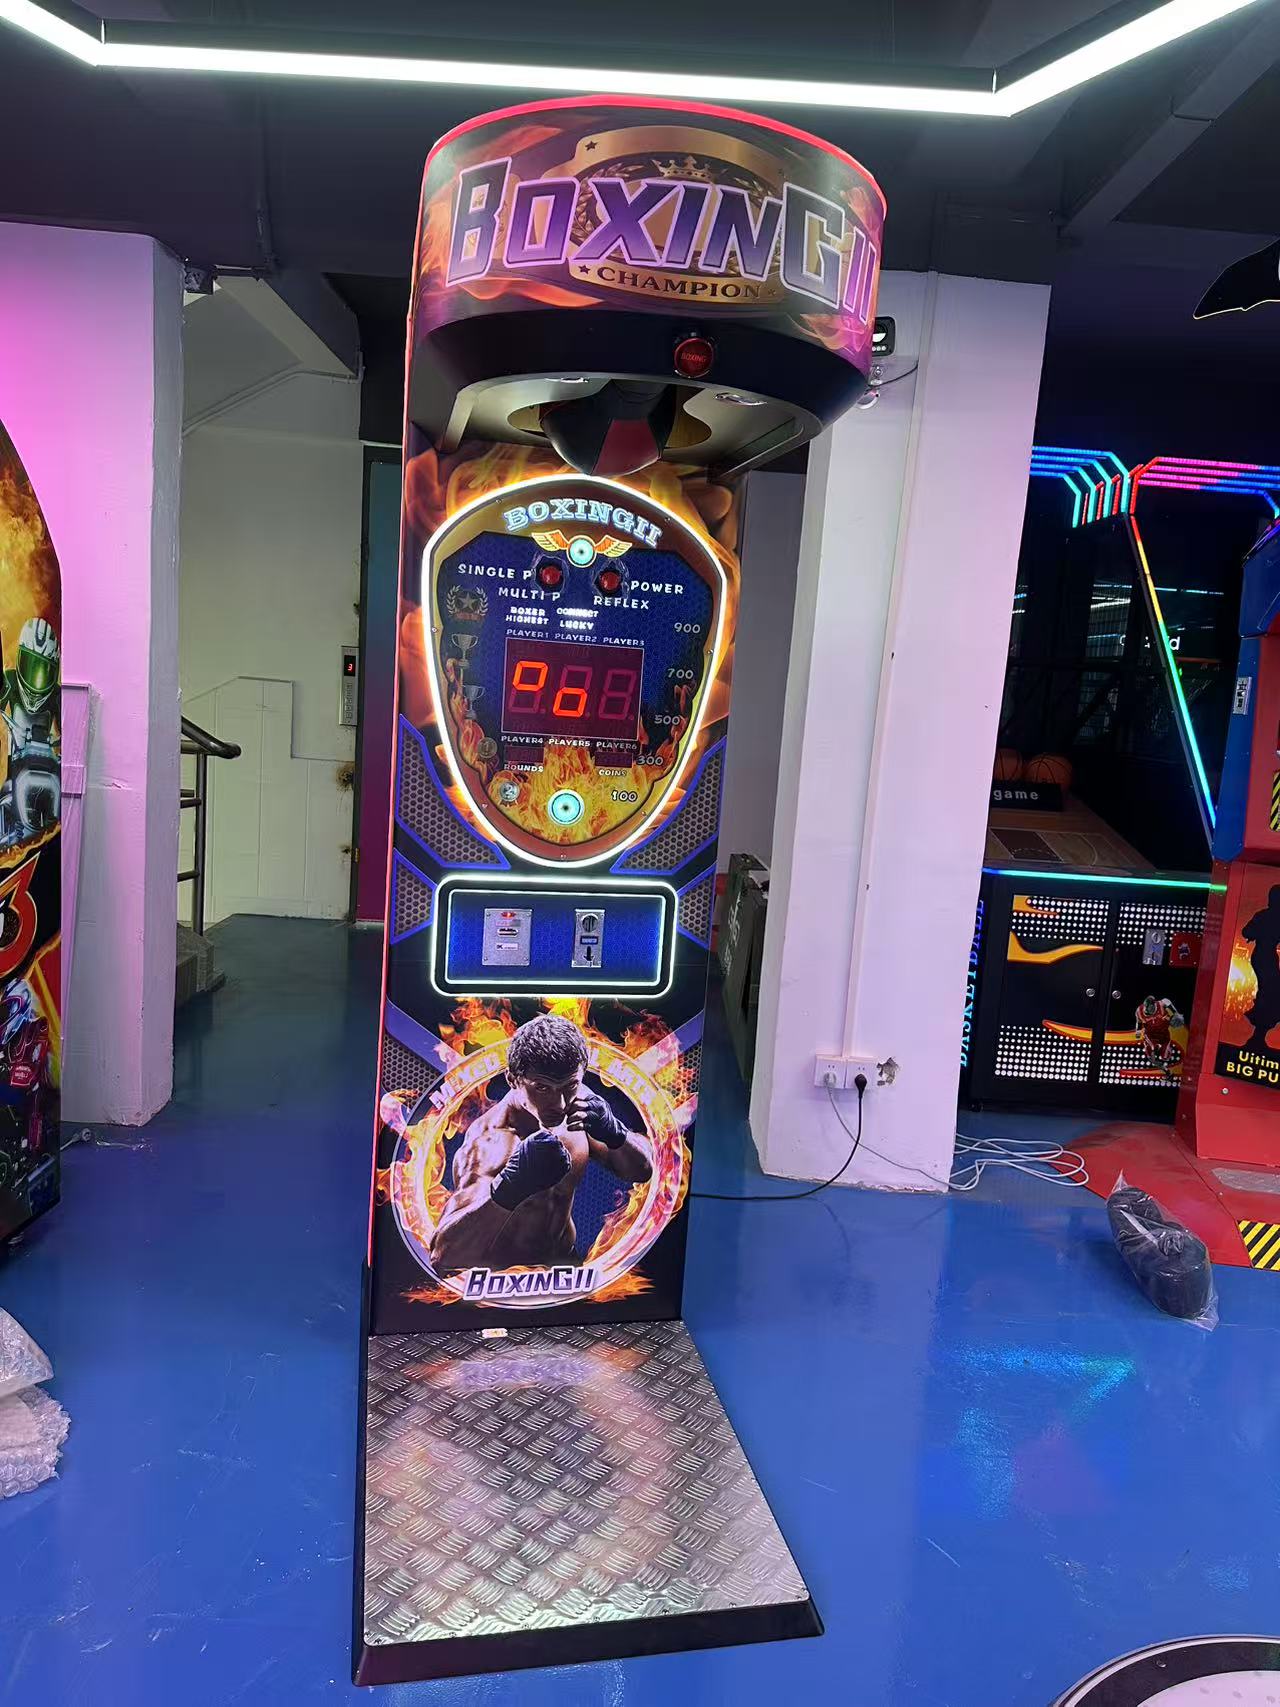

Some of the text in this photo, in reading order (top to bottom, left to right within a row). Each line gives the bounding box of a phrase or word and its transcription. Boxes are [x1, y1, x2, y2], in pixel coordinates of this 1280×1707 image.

[597, 266, 761, 298] CHAMPION
[458, 564, 533, 580] SINGLE P
[498, 586, 561, 602] MULTI P
[630, 580, 684, 595] POWER
[594, 595, 650, 610] REFLEX
[510, 606, 546, 617] BOXER
[505, 614, 549, 625] HIGHEST
[559, 619, 594, 631] LUCKY
[674, 622, 701, 634] 900
[506, 628, 645, 647] PLAYER1 PLAYER2 PLAYER3
[668, 668, 694, 680] 700
[654, 714, 681, 726] 500
[501, 735, 638, 751] PLAYER4 PLAYER5 PLAYER6
[637, 755, 664, 767] 300
[503, 763, 628, 777] ROUNDS COINS
[611, 789, 638, 802] 100
[993, 789, 1039, 800] game
[1226, 1061, 1279, 1083] BIG PU
